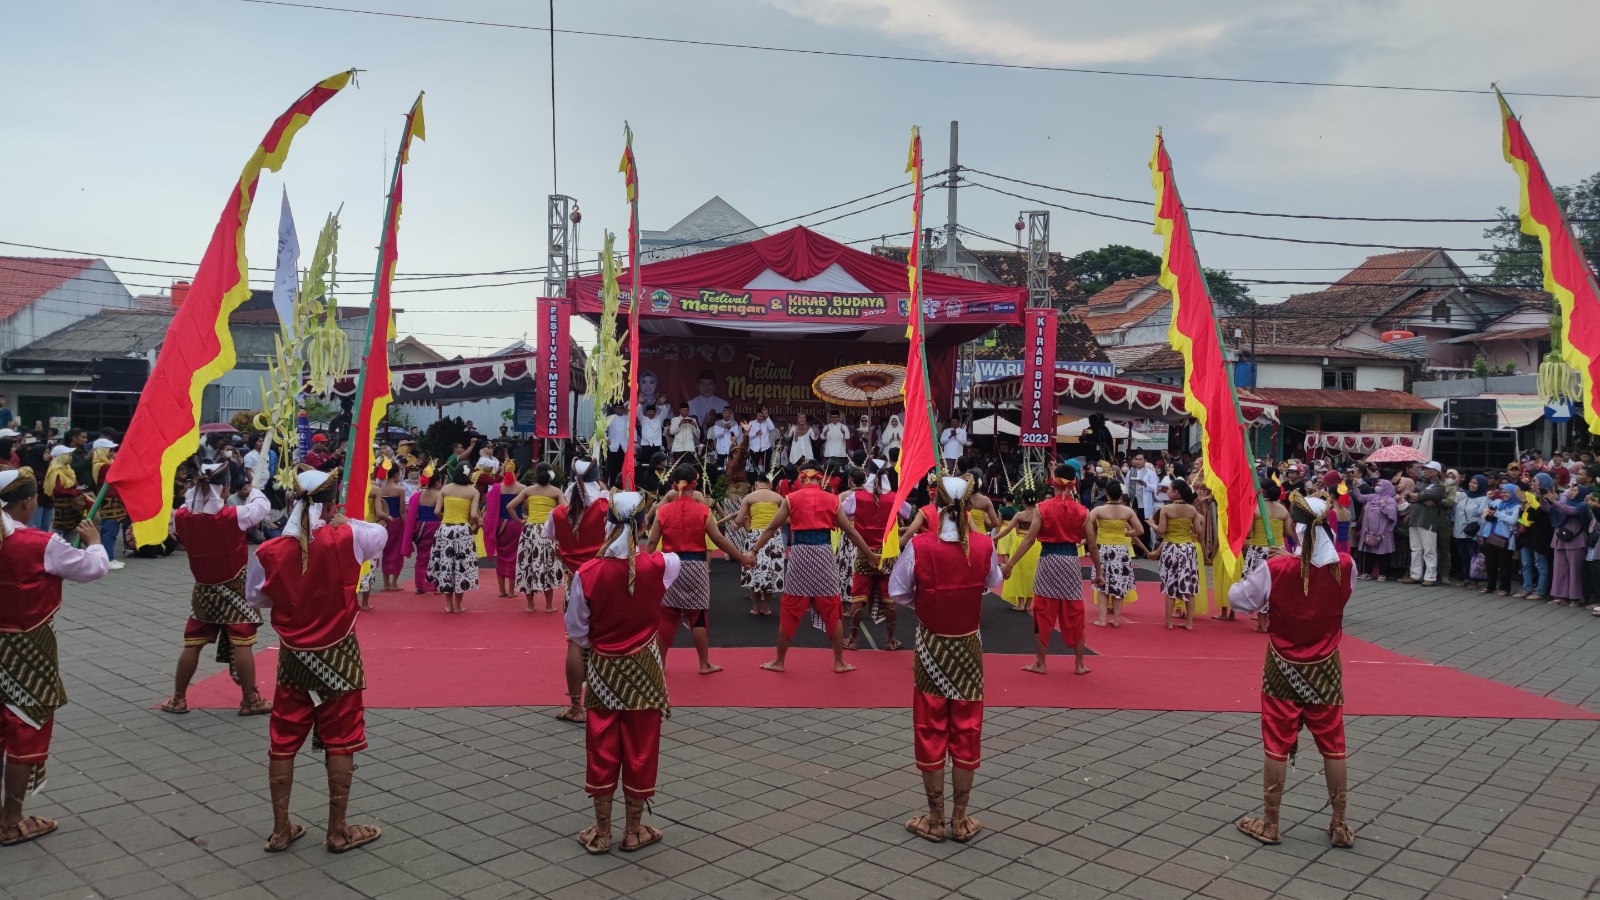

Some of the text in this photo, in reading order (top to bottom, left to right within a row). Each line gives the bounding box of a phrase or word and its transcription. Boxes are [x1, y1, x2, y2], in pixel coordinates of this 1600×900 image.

[700, 290, 750, 304] Festival
[787, 294, 885, 308] KIRAB BUDAYA
[680, 299, 766, 315] Megengan
[770, 298, 783, 310] &
[787, 306, 887, 317] Kota Wali 2023
[548, 306, 558, 435] FESTIVAL MEGENGAN
[746, 353, 796, 381] Festival
[1032, 317, 1045, 429] KIRAB BUDAYA
[725, 375, 811, 405] Megengan
[735, 404, 757, 415] Hari
[1022, 433, 1049, 444] 2023
